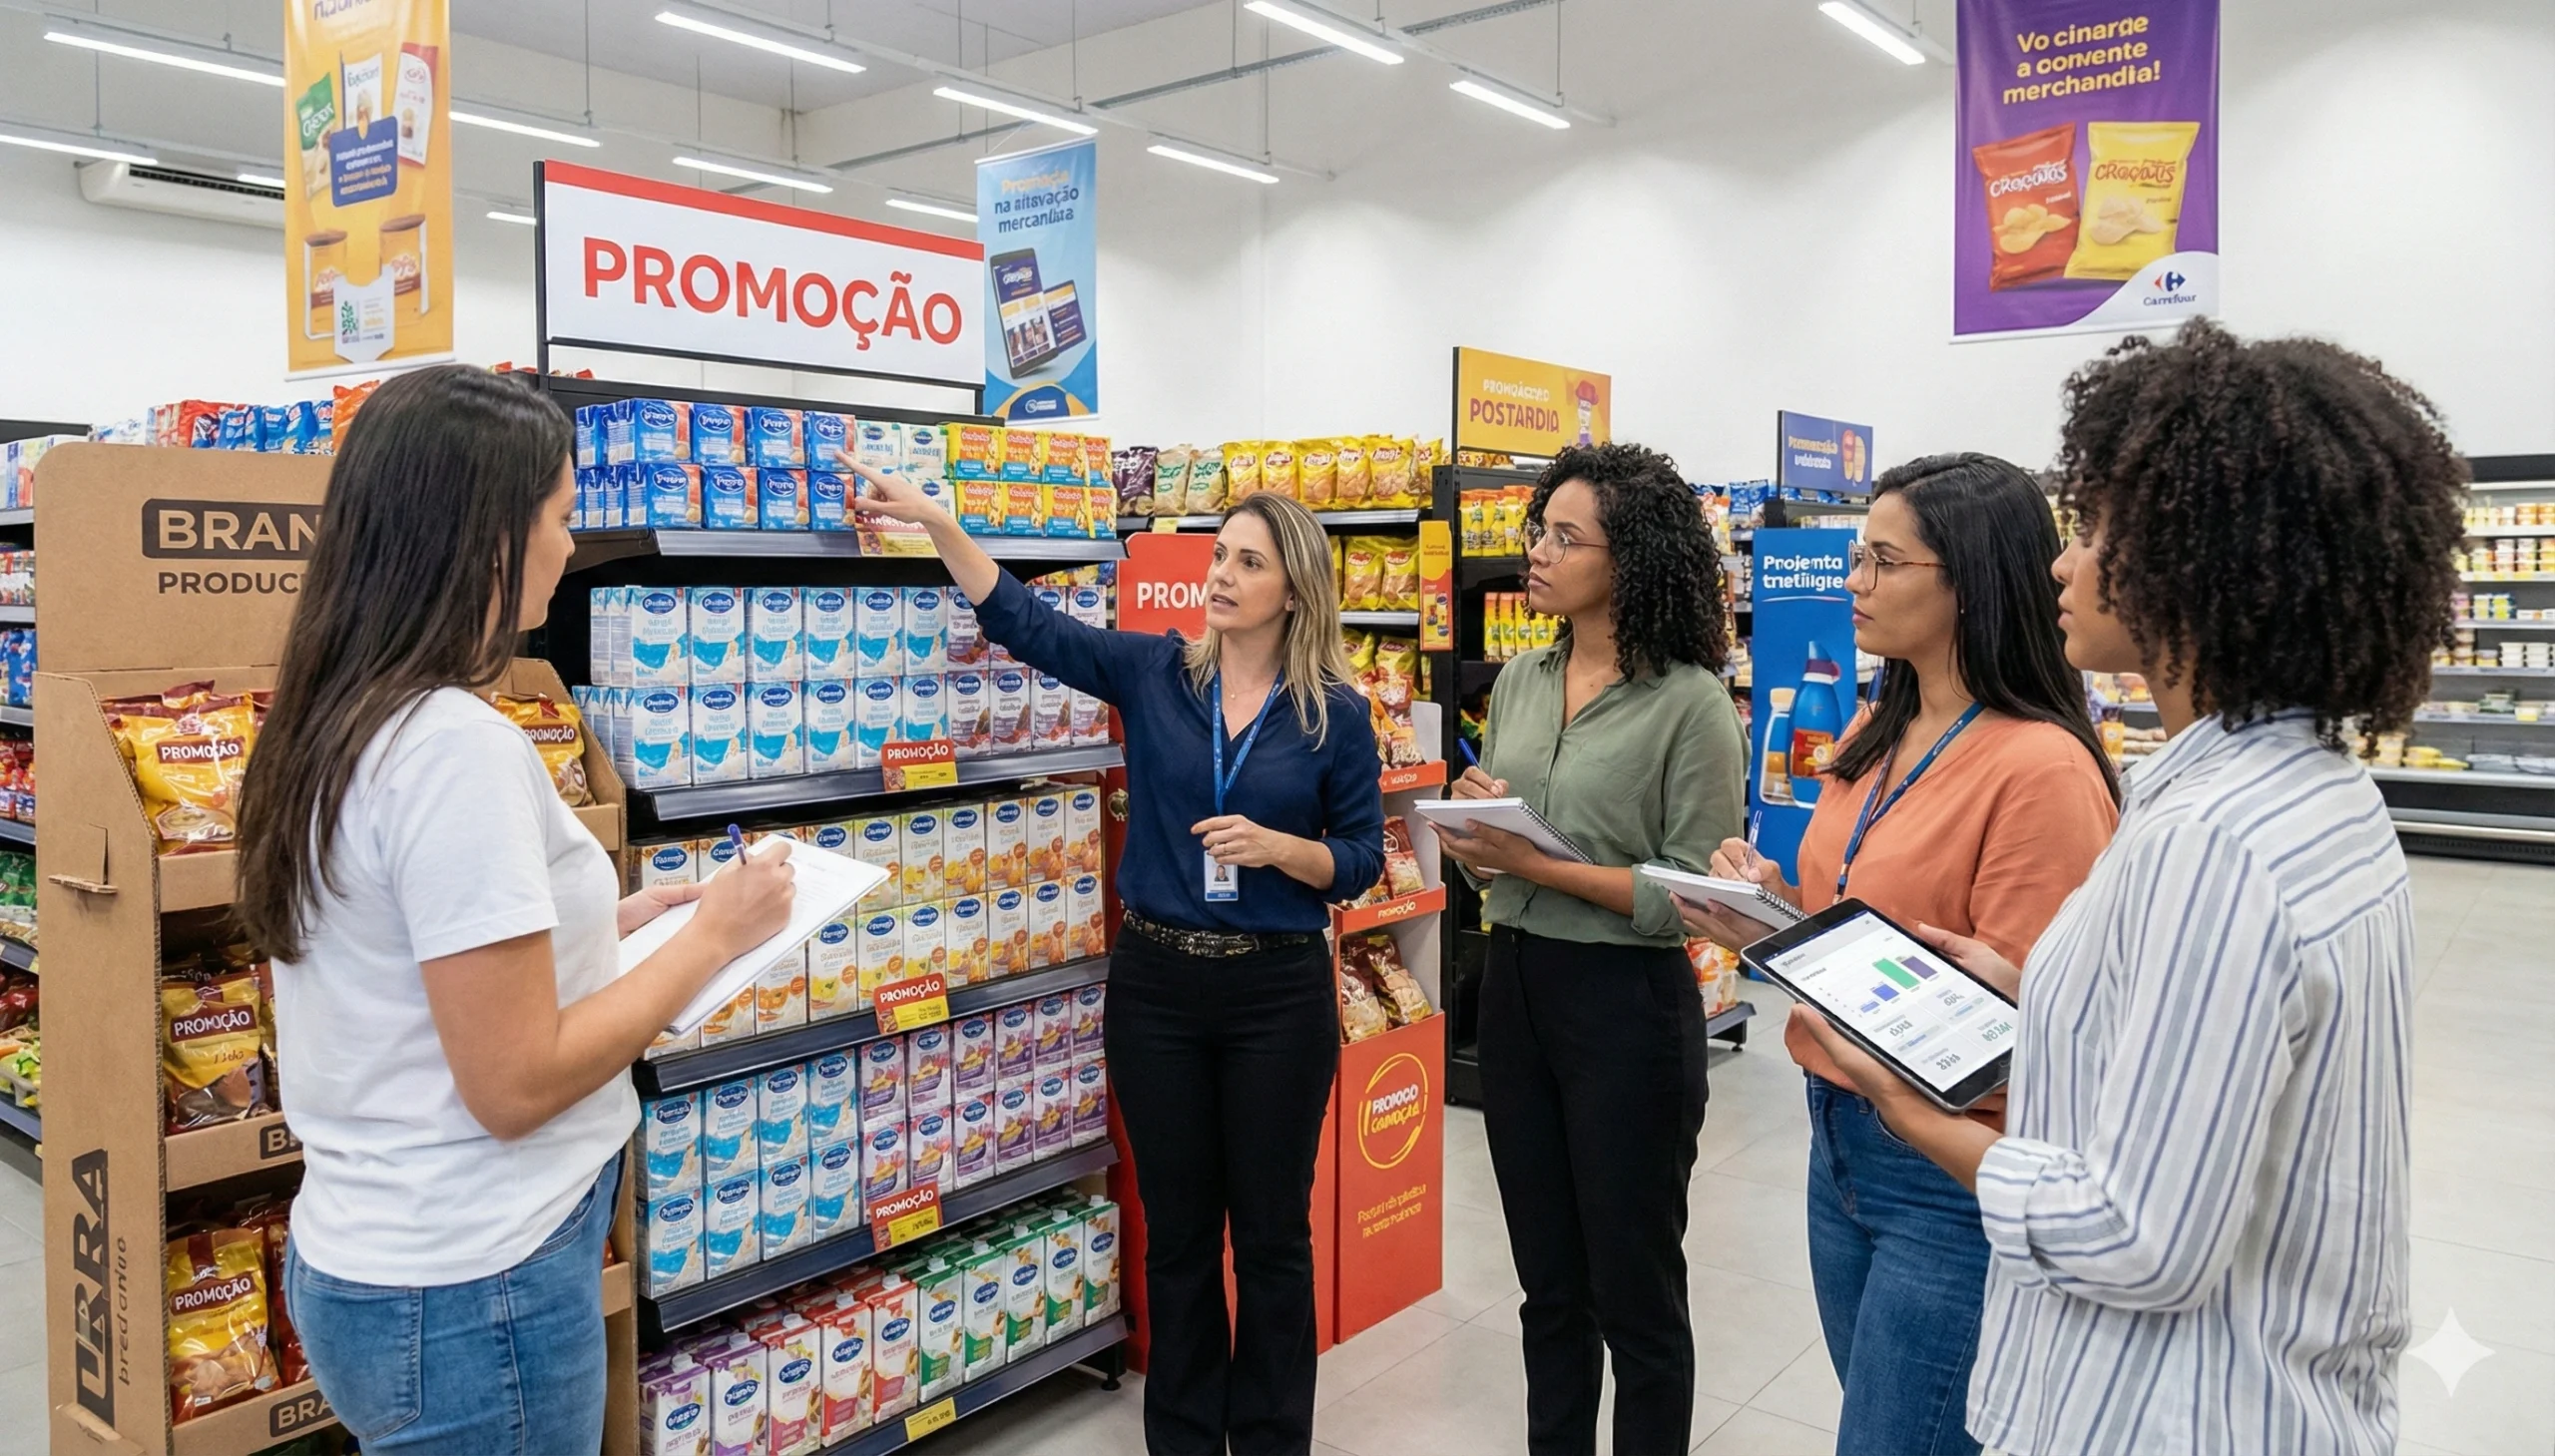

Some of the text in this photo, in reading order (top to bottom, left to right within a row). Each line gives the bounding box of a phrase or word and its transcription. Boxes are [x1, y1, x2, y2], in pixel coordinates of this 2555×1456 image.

[2017, 32, 2050, 53] Vo
[2003, 60, 2161, 105] merchandia!
[2016, 62, 2031, 78] a
[995, 201, 1011, 214] na
[583, 236, 963, 350] PROMOÇÃO
[1470, 397, 1560, 433] POSTARDIA
[159, 509, 321, 551] BRAN
[159, 571, 305, 595] PRODUC
[1137, 582, 1208, 609] PROM
[887, 742, 949, 760] PROMOÇÃO
[879, 979, 940, 1003] PROMOÇÃO
[174, 1009, 250, 1036] PROMOÇÃO
[875, 1190, 934, 1218] PROMOÇÃO
[175, 1277, 251, 1310] PROMOÇÃO
[277, 1398, 331, 1429] BRA
